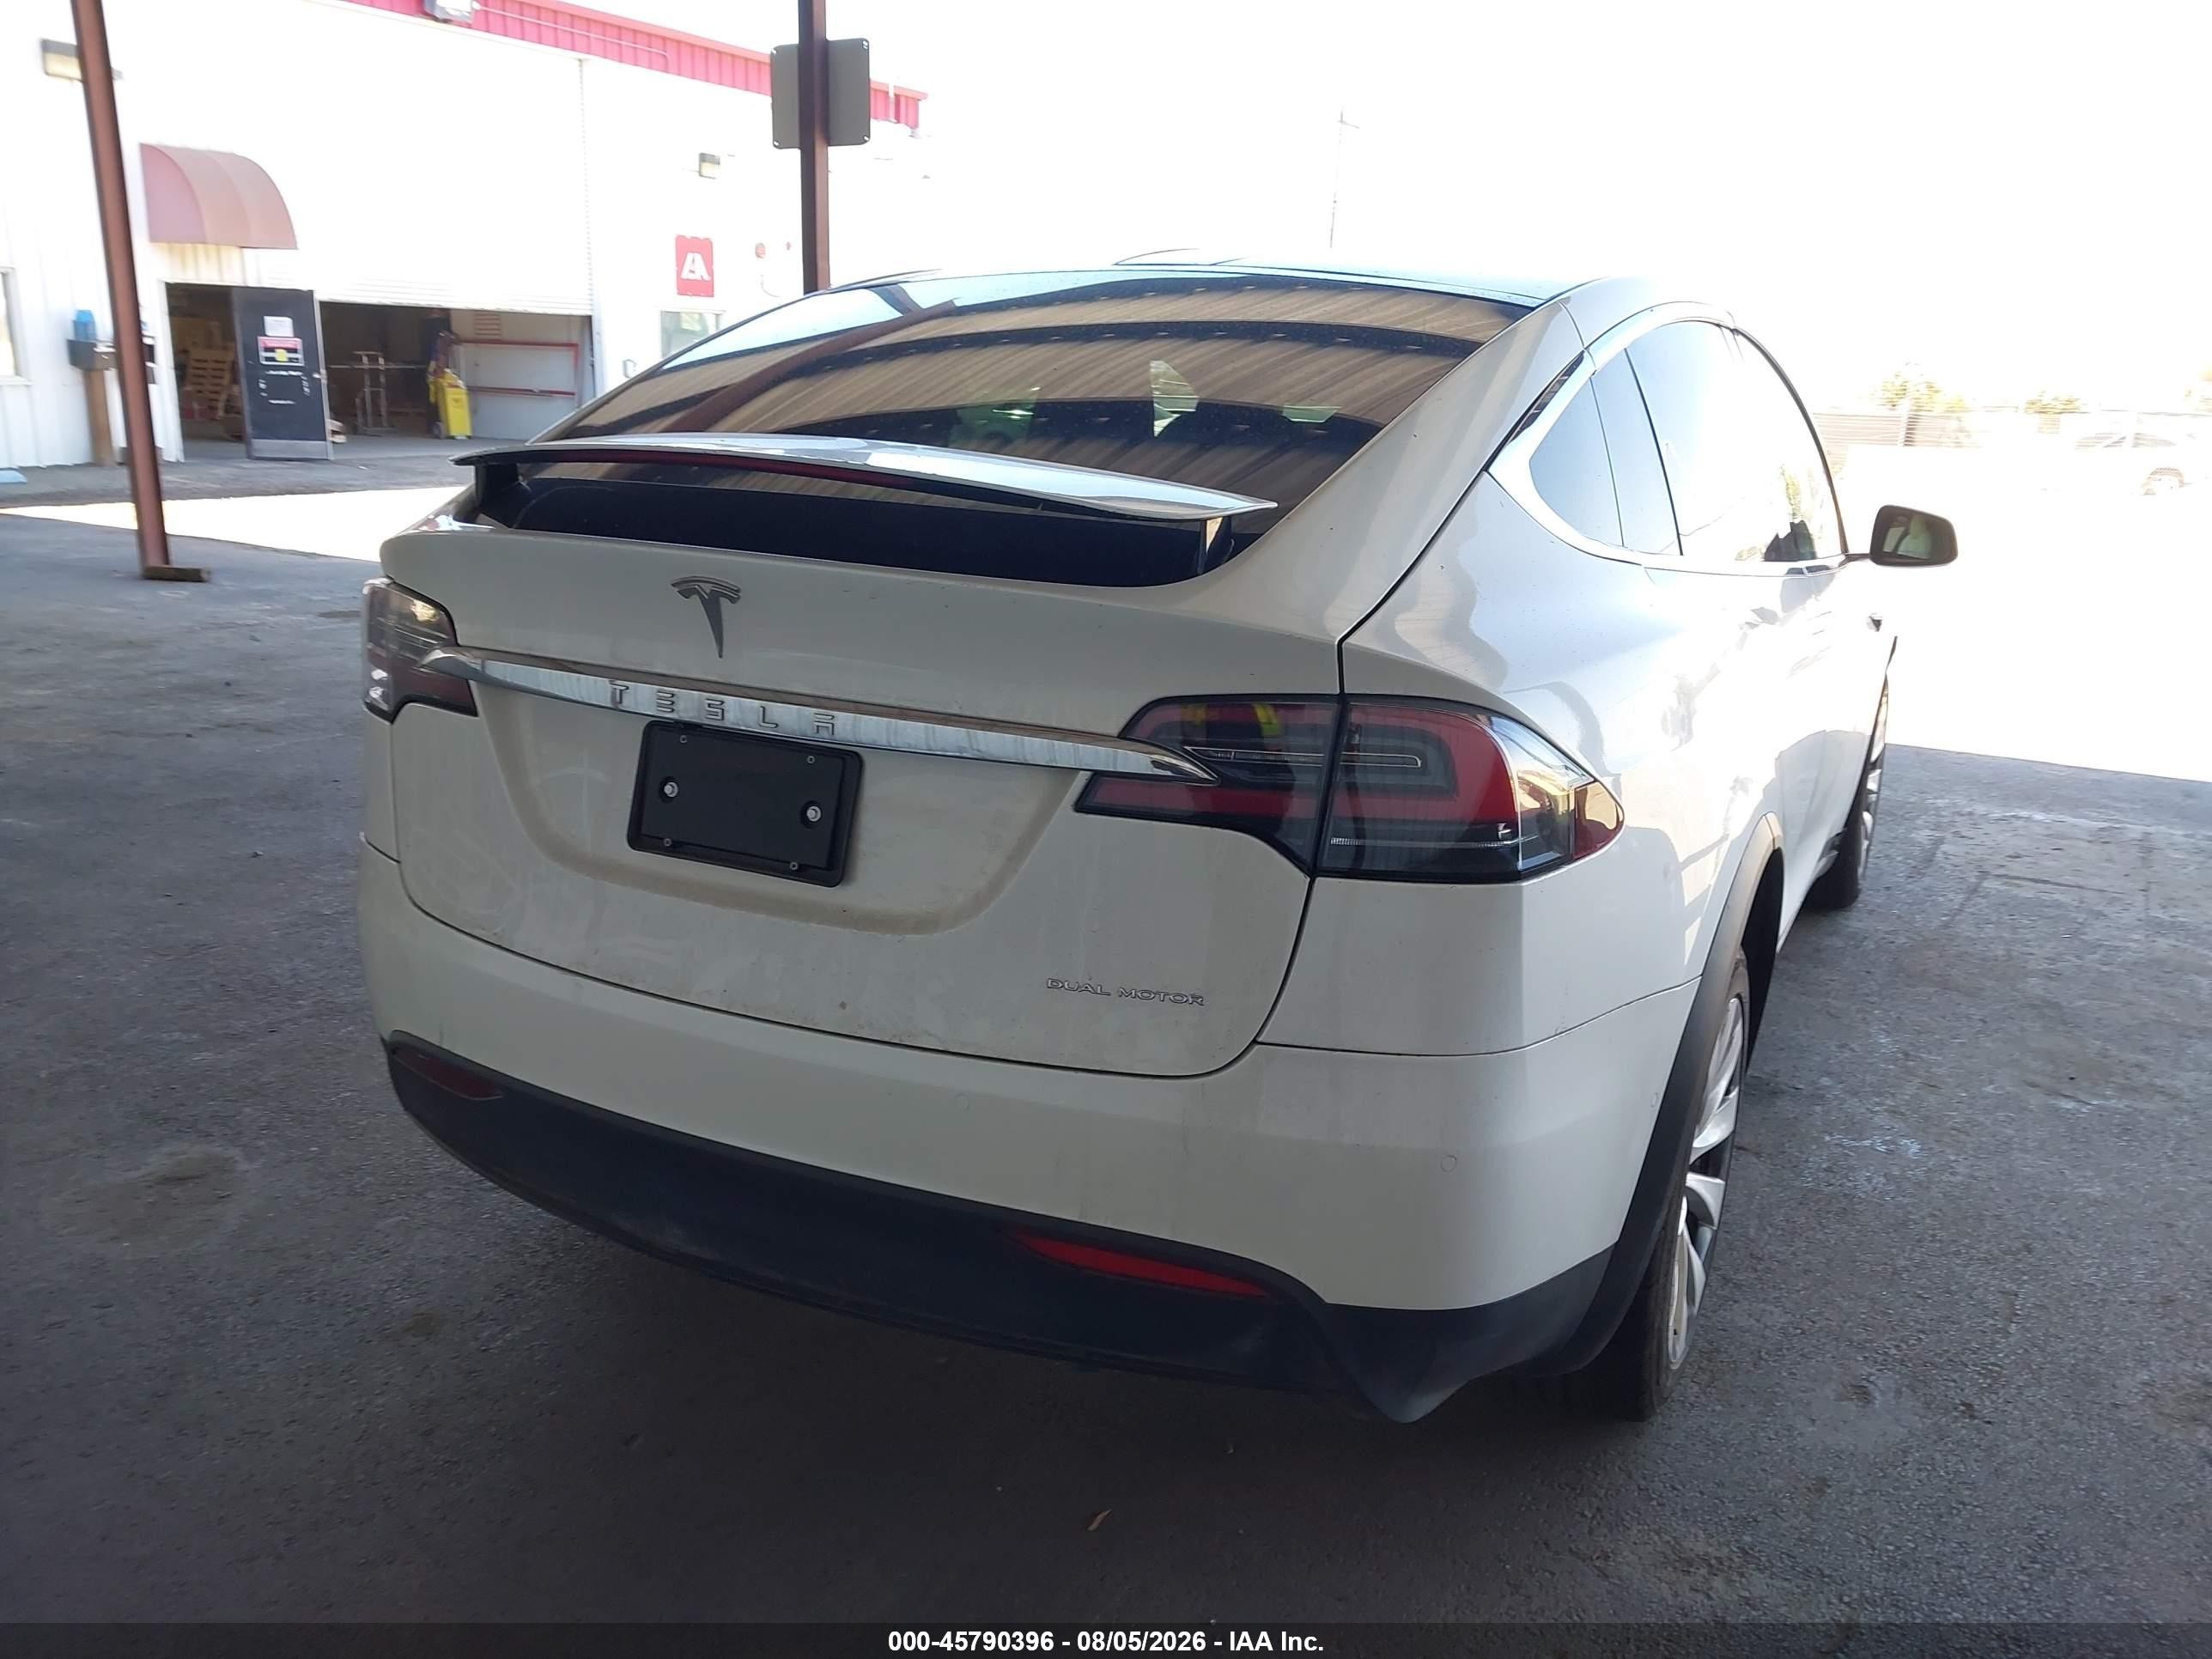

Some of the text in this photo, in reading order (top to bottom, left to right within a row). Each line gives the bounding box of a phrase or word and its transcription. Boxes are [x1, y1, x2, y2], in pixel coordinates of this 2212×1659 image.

[609, 683, 835, 736] TESLA
[1046, 977, 1205, 1006] DUAL MOTOR
